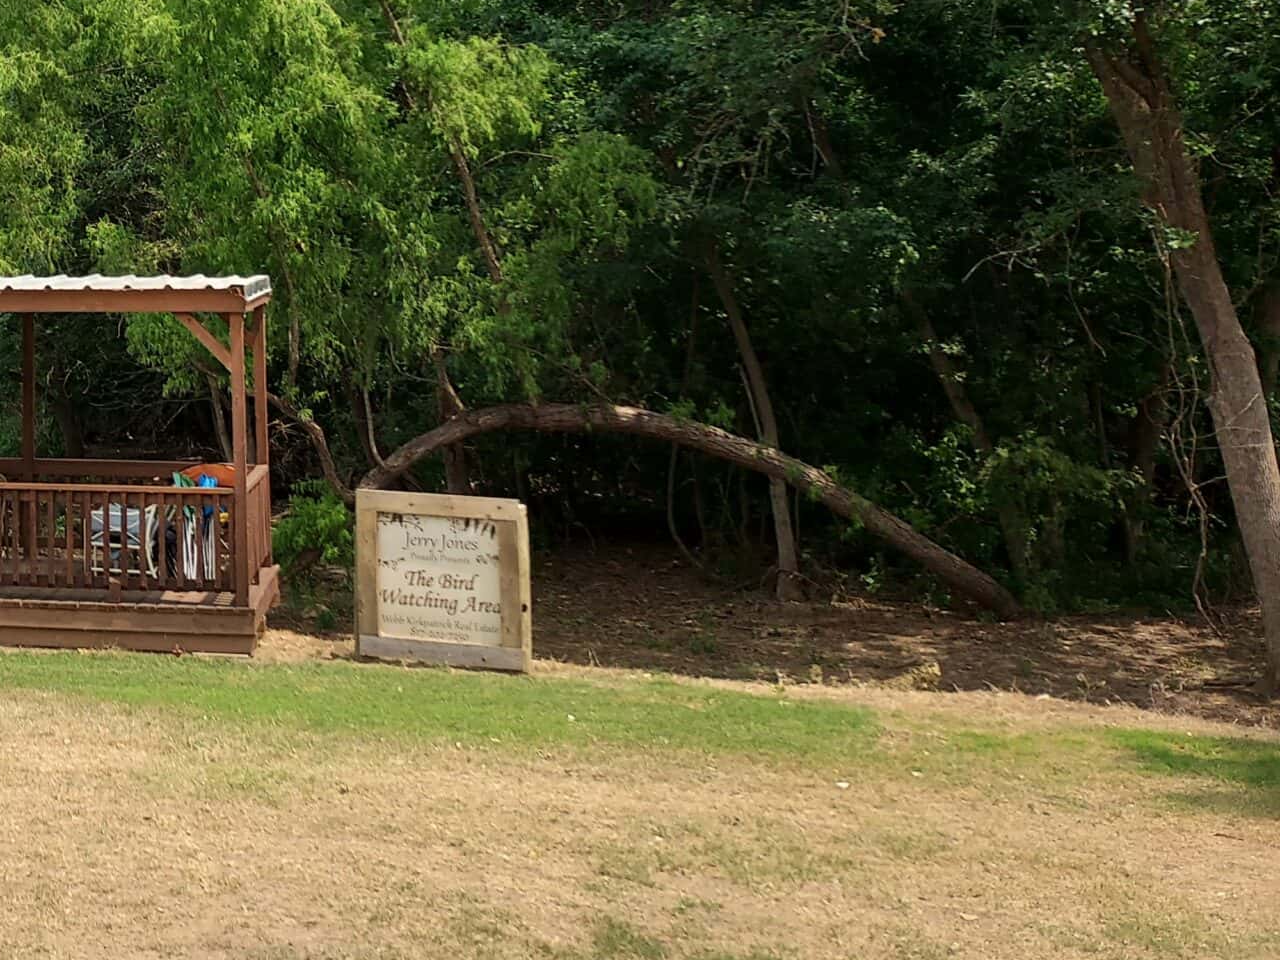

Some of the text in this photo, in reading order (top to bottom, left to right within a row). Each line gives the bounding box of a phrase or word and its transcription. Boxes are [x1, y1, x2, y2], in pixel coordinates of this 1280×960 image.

[402, 532, 479, 552] Jerry Jones
[404, 569, 480, 591] The Bird
[379, 588, 502, 615] Watching Area
